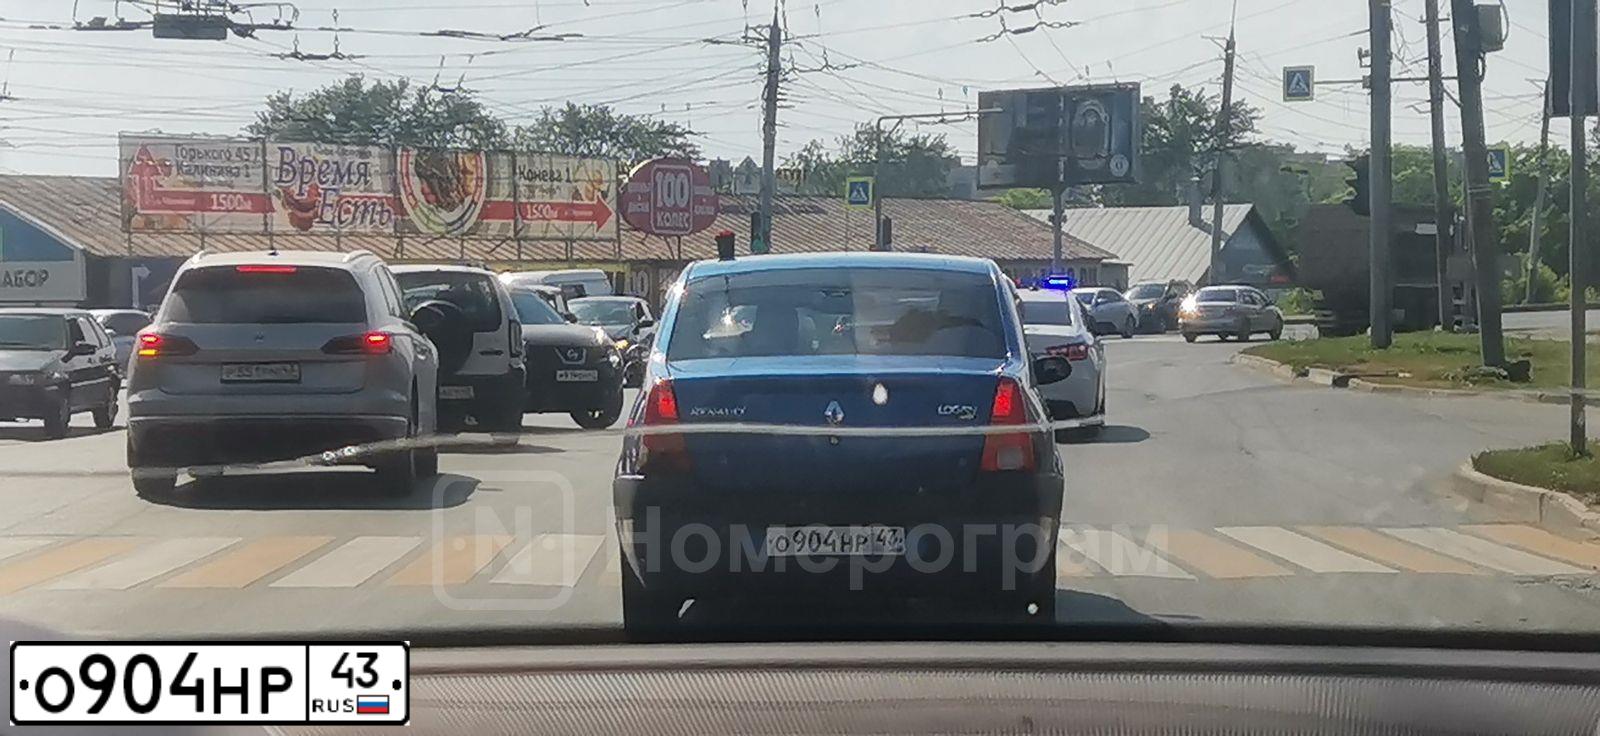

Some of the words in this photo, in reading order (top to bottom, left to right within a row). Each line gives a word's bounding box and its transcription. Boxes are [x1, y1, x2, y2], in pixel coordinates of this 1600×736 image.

[275, 146, 371, 197] Время
[655, 171, 690, 208] 100
[315, 187, 392, 226] Есть
